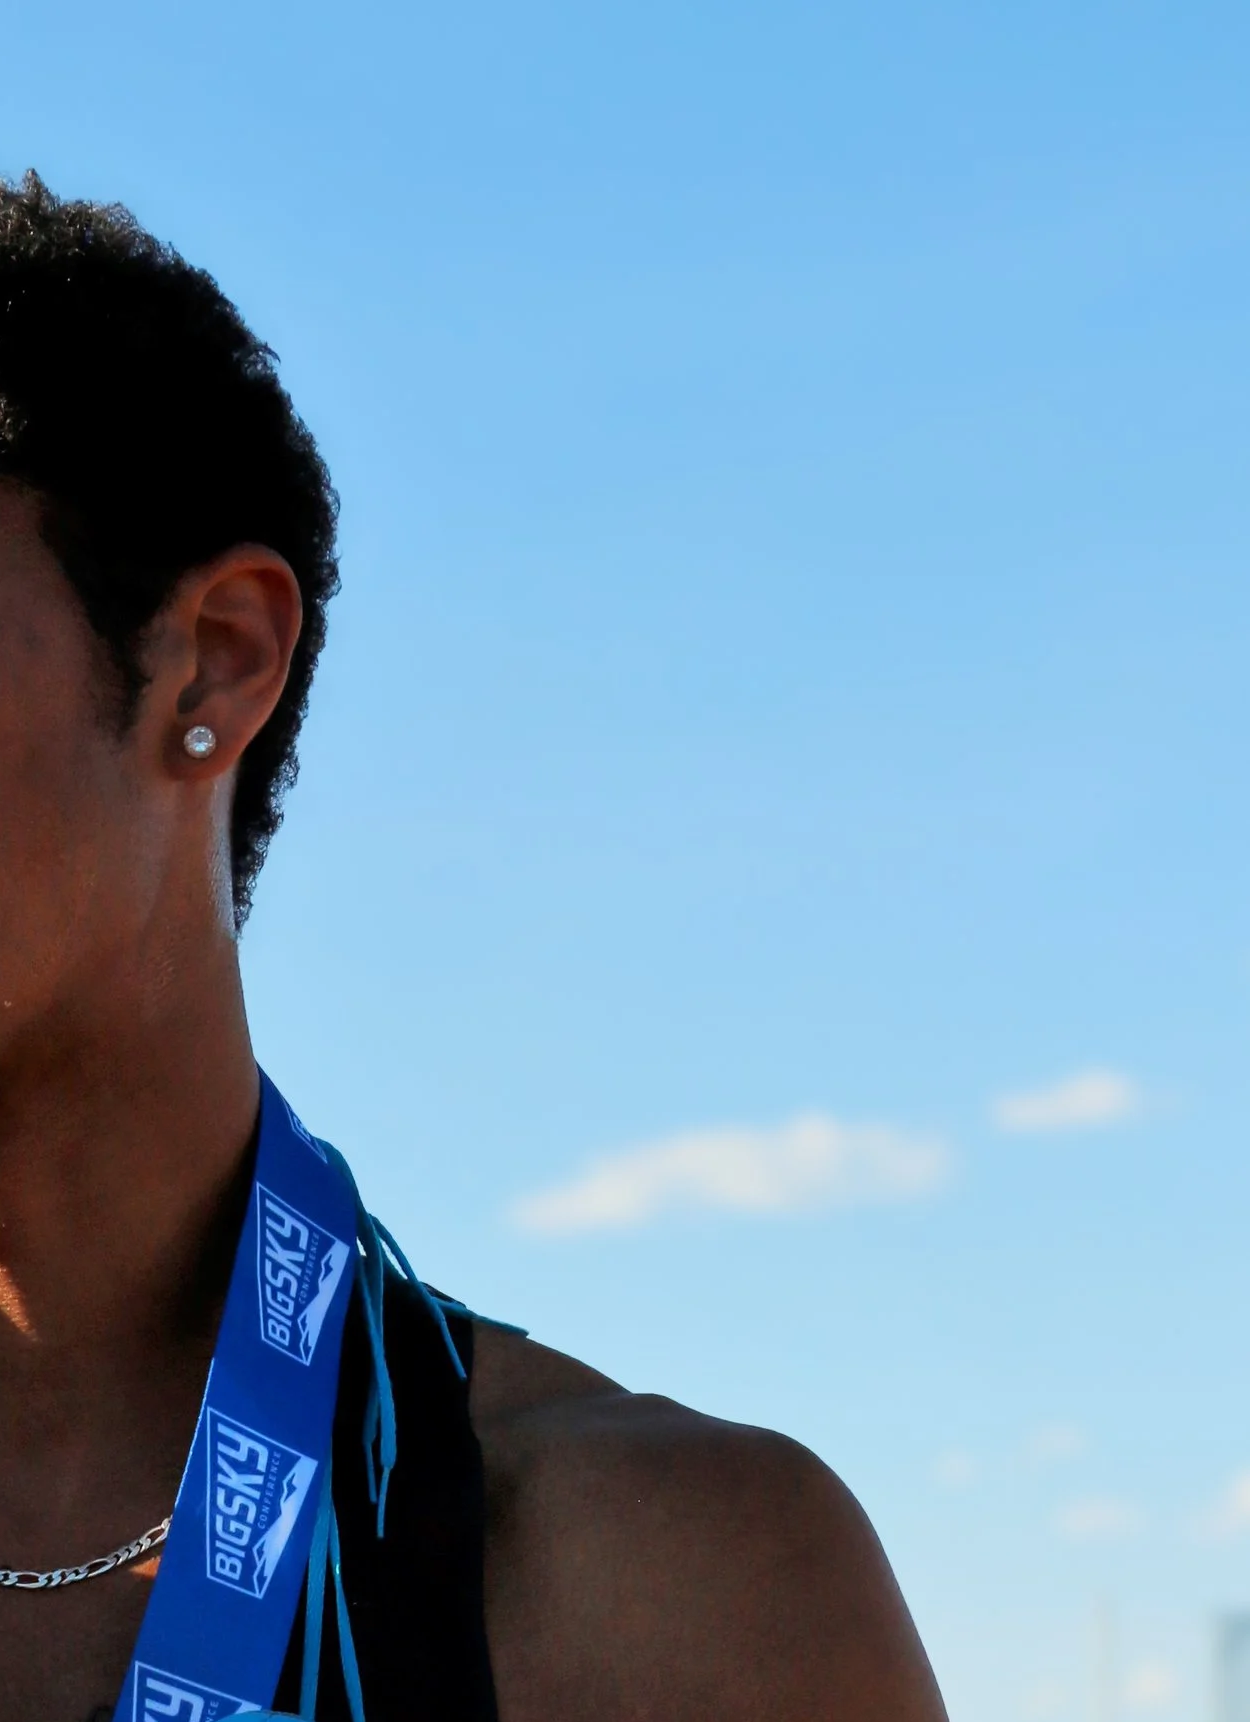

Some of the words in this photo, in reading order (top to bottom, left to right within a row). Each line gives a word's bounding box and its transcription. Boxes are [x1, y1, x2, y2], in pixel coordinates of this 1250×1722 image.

[266, 1199, 310, 1346] BIGSKY
[215, 1423, 269, 1581] BIGSKY
[258, 1452, 282, 1529] CONFERENCE
